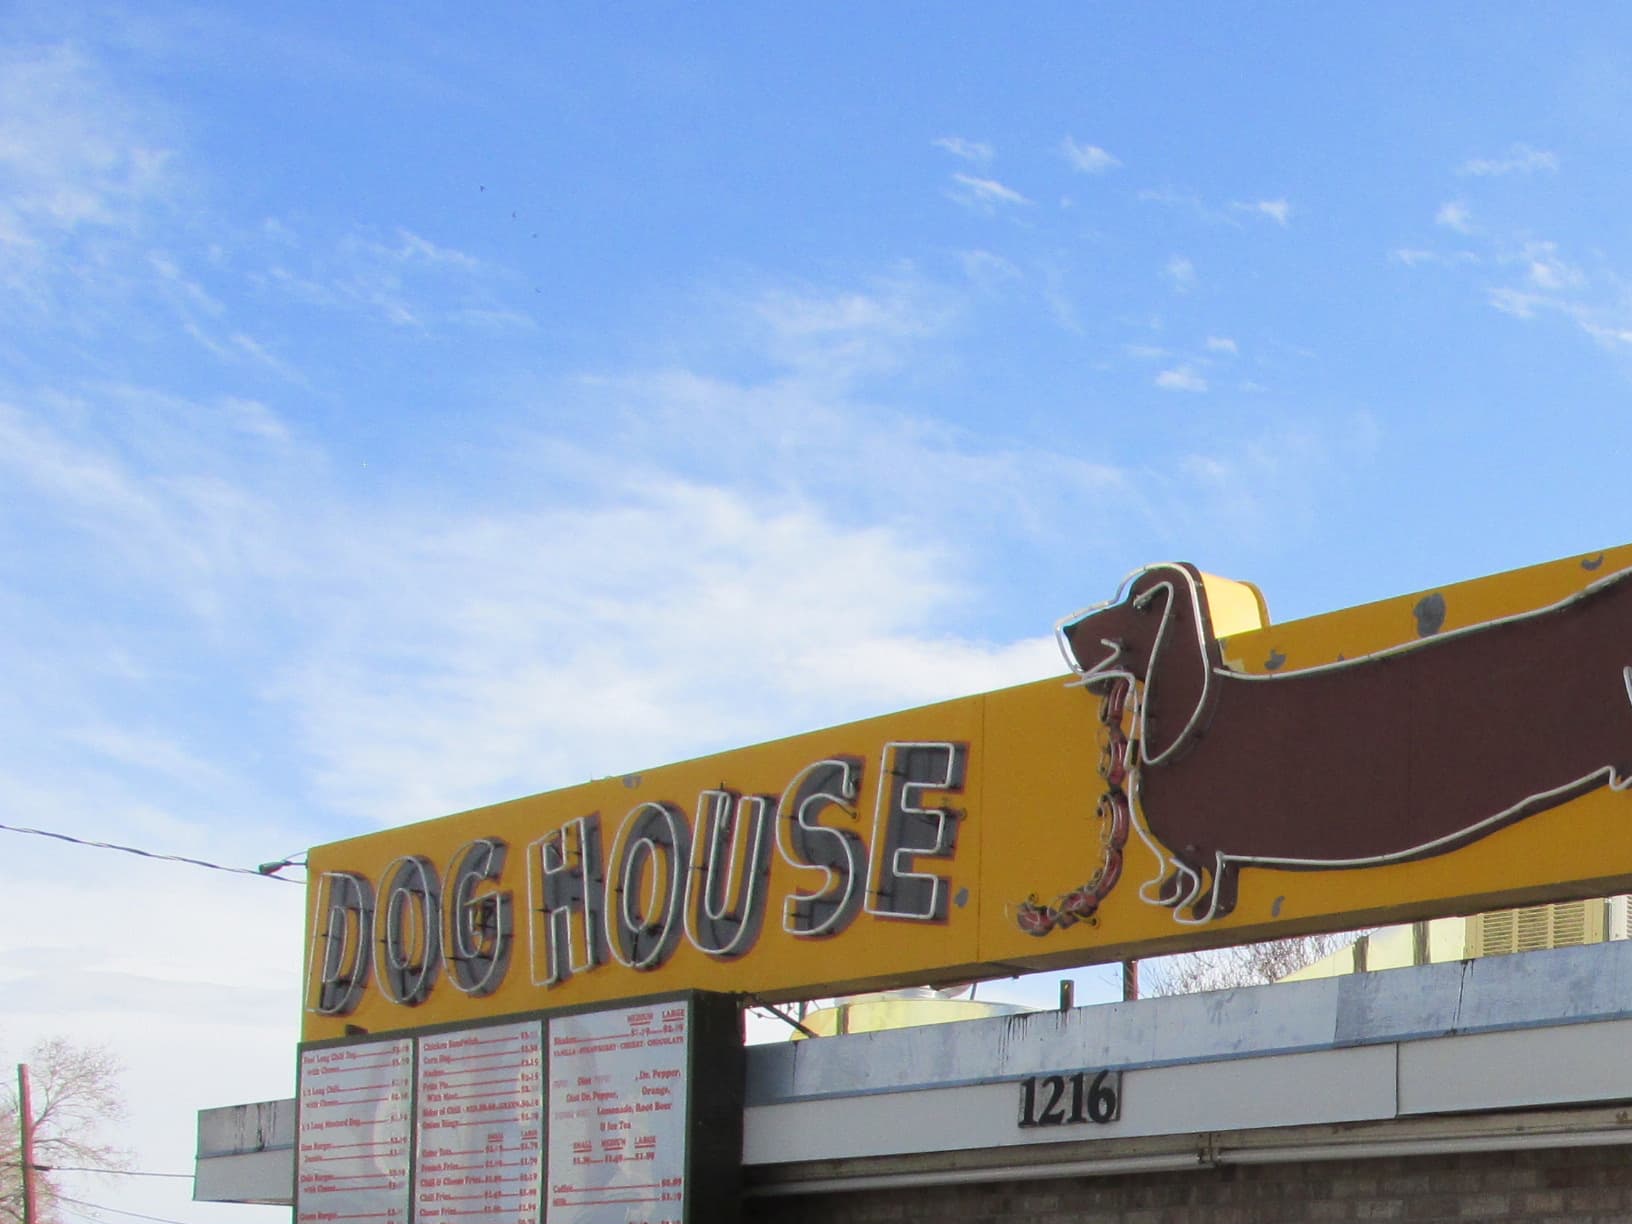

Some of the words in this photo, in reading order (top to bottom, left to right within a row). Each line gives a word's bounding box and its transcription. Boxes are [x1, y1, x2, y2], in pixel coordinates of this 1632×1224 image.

[307, 838, 513, 1015] DOG
[527, 740, 969, 987] HOUSE
[647, 1036, 683, 1045] CHOCOLATE
[635, 1102, 652, 1111] Root
[654, 1101, 671, 1110] Beer
[1018, 1070, 1115, 1127] 1216
